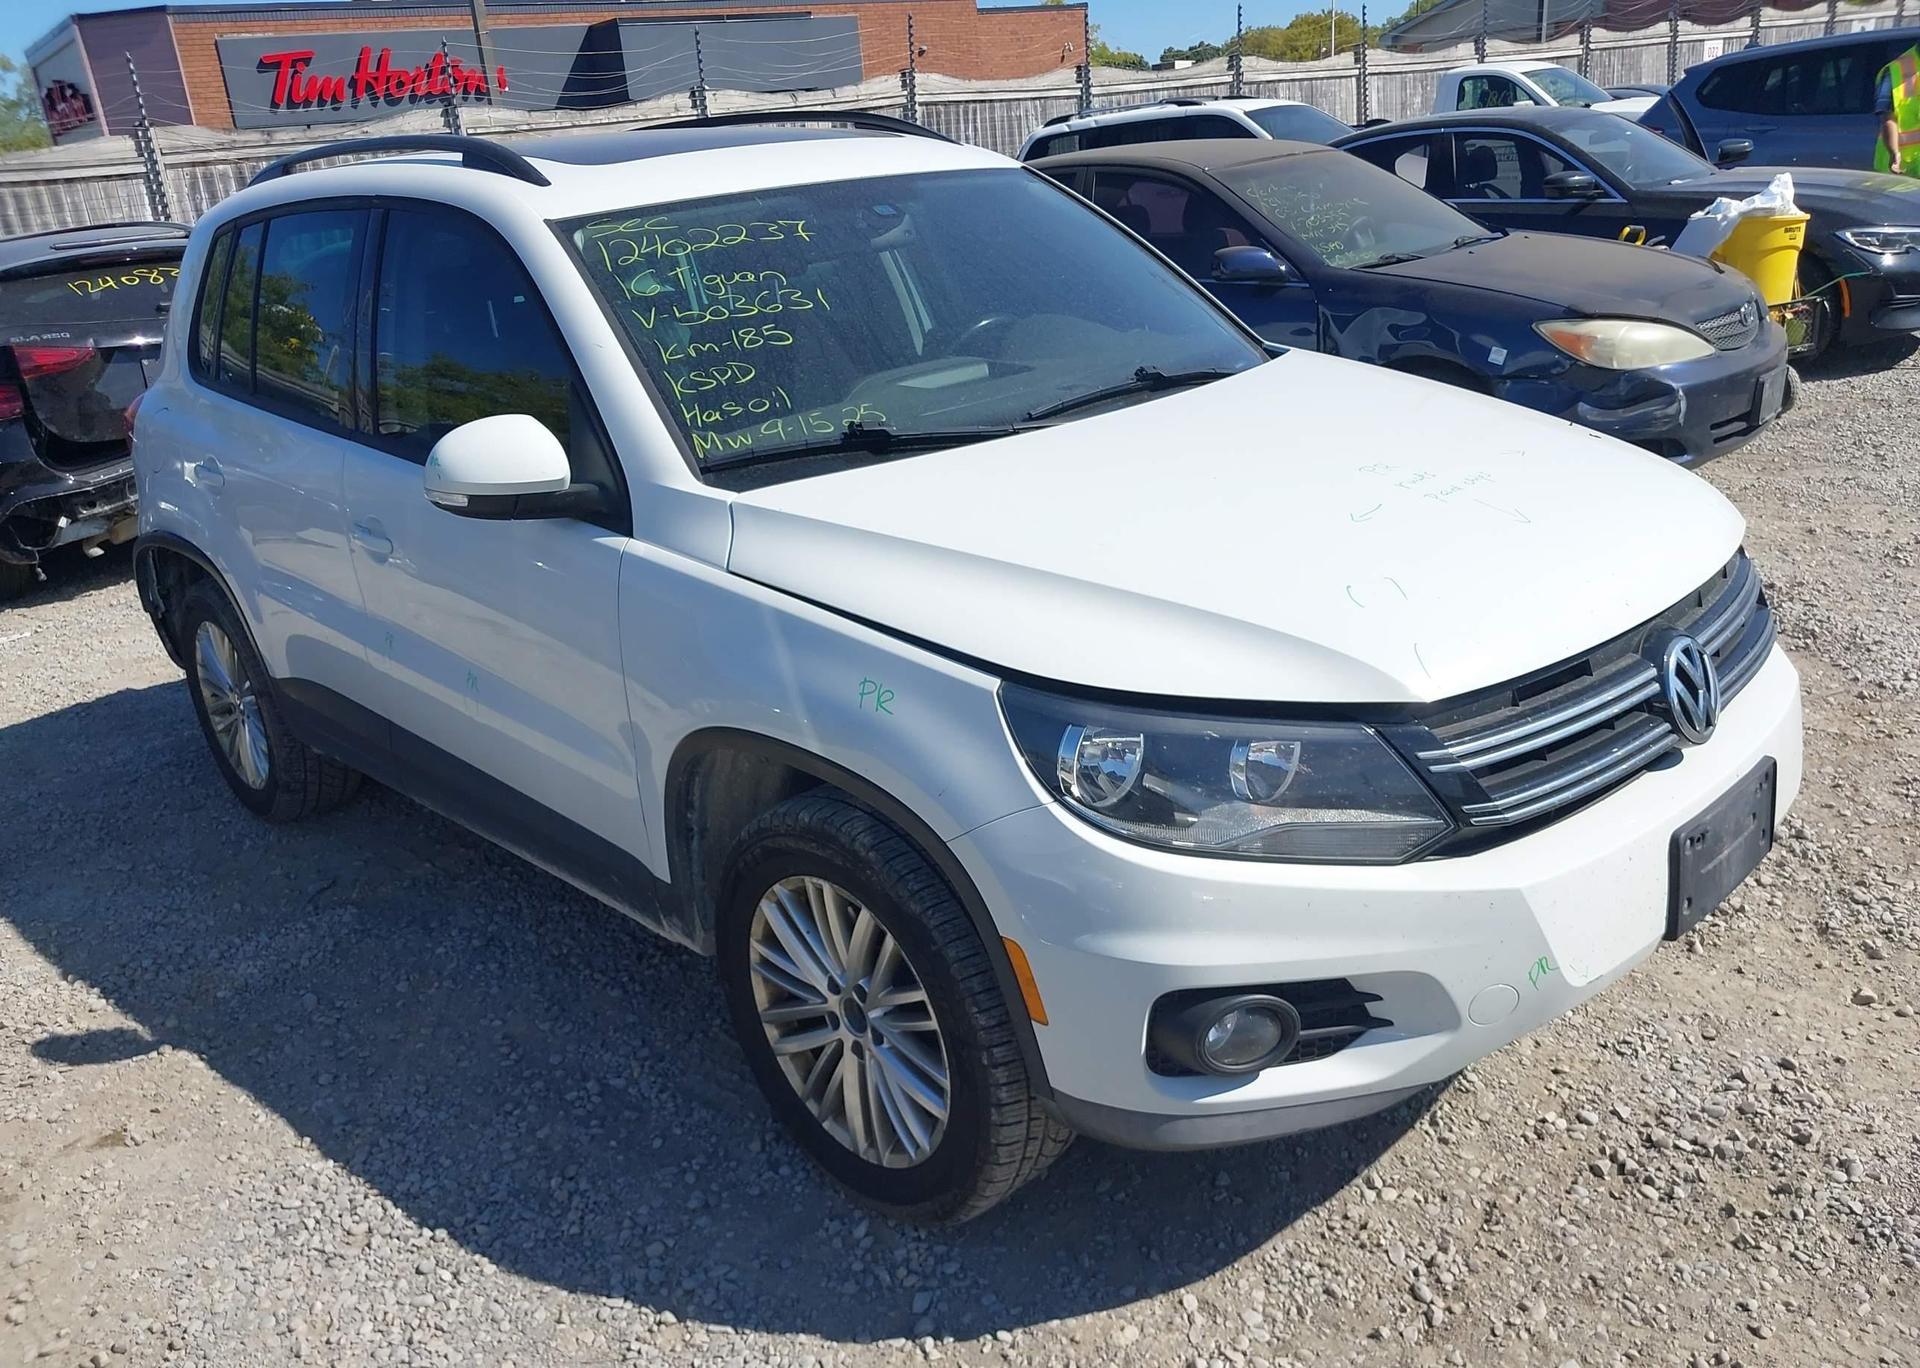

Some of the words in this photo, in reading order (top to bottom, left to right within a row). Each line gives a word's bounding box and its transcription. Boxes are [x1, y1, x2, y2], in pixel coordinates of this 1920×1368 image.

[257, 50, 347, 113] Tim
[598, 220, 816, 272] 12402237
[614, 269, 662, 300] 16
[668, 267, 787, 295] Tiguan
[632, 288, 830, 328] V-503631
